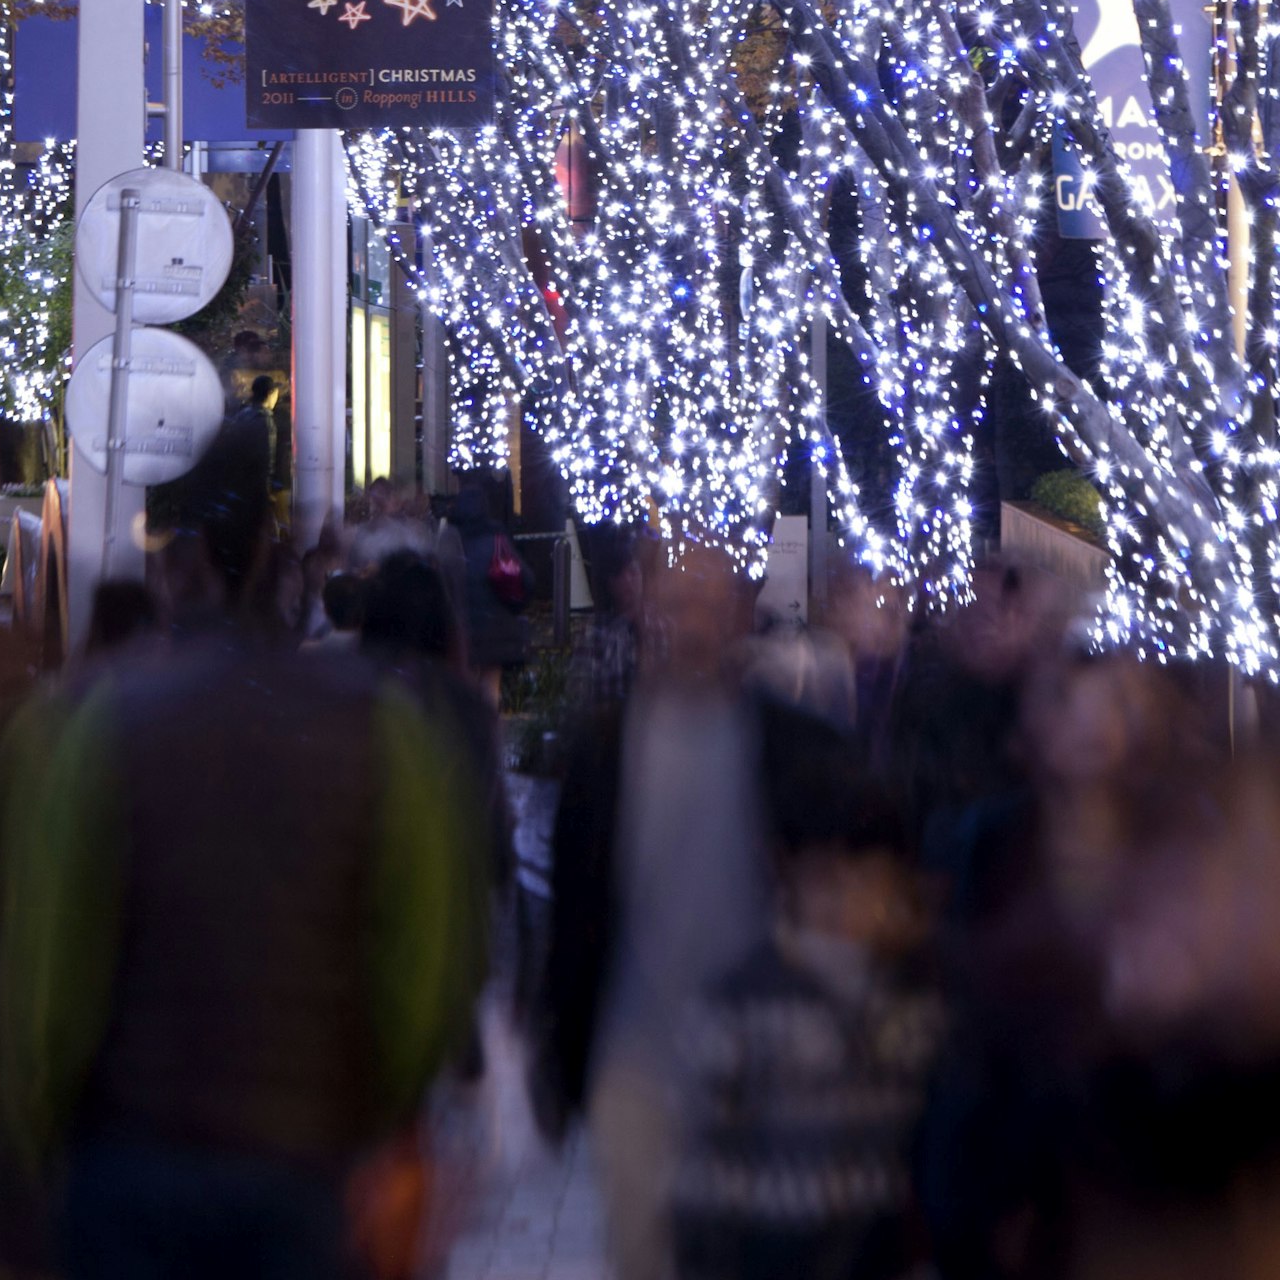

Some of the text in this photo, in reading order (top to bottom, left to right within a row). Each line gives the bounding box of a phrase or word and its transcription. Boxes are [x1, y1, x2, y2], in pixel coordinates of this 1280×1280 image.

[378, 68, 477, 83] CHRISTMAS
[262, 92, 294, 104] 2011
[363, 90, 422, 109] Roppongi
[426, 90, 477, 103] HILLS
[1113, 142, 1166, 160] ROM
